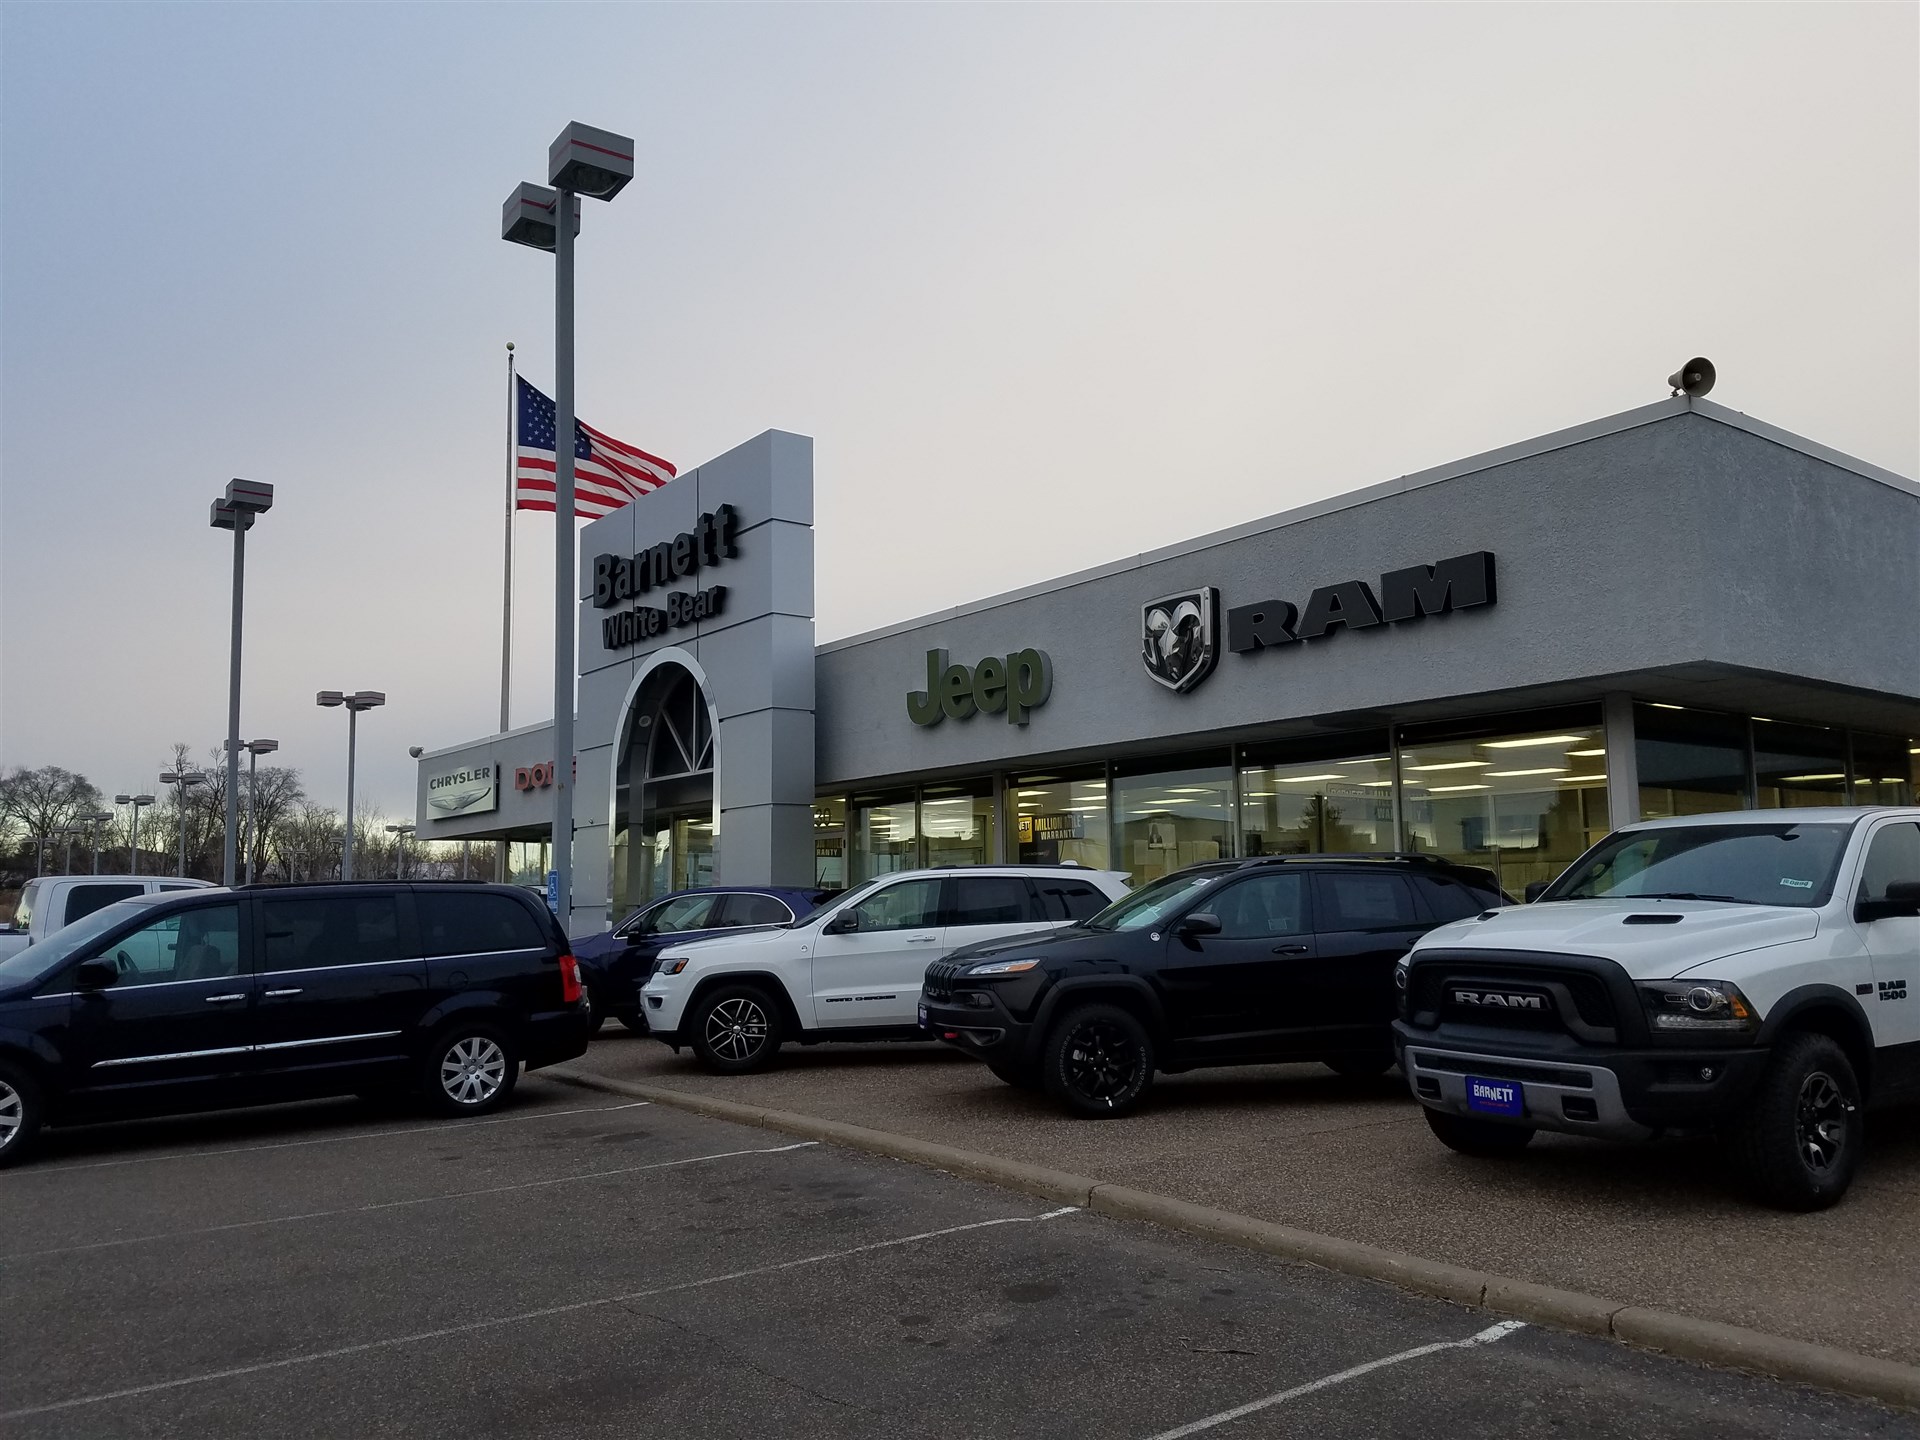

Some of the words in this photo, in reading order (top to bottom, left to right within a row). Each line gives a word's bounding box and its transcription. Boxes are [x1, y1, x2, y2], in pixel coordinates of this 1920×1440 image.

[593, 503, 738, 609] Barnett
[1227, 551, 1497, 653] RAM
[602, 605, 668, 650] White
[666, 585, 728, 628] Bear
[906, 648, 1053, 726] Jeep
[430, 767, 490, 790] CHRYSLER
[1034, 816, 1063, 831] MILLION
[1040, 829, 1076, 841] WARRANTY
[1878, 980, 1907, 991] RAM
[1455, 991, 1541, 1009] RAM
[1879, 990, 1907, 1001] 1500
[1473, 1084, 1514, 1103] BARNETT
